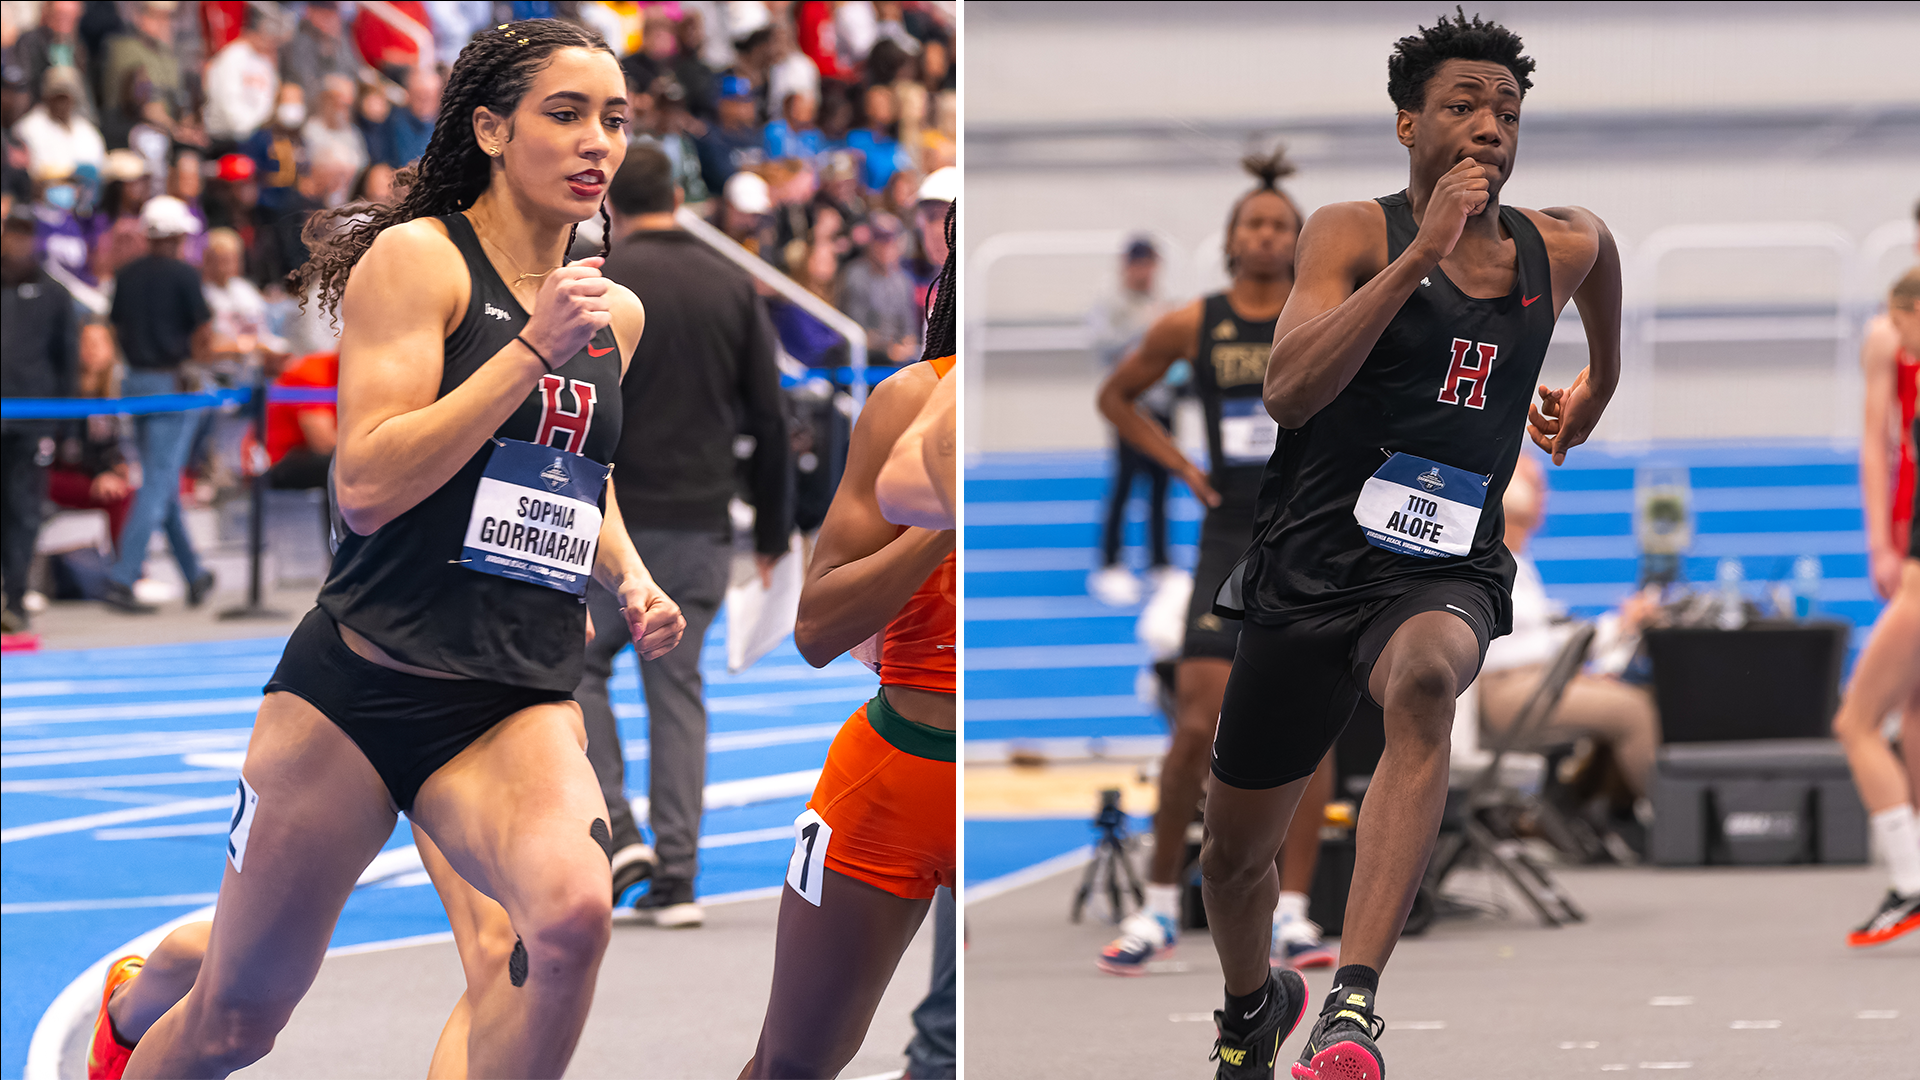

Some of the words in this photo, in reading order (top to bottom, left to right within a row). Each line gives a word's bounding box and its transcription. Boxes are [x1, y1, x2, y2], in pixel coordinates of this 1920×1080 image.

[1437, 337, 1498, 410] H
[530, 374, 597, 457] H
[516, 496, 576, 530] SOPHIA
[1407, 494, 1438, 518] TITO
[480, 516, 591, 566] GORRIARAN
[1386, 510, 1444, 544] ALOFE
[799, 822, 820, 893] 1
[1348, 993, 1366, 1002] NIKE
[1219, 1045, 1247, 1067] NIKE
